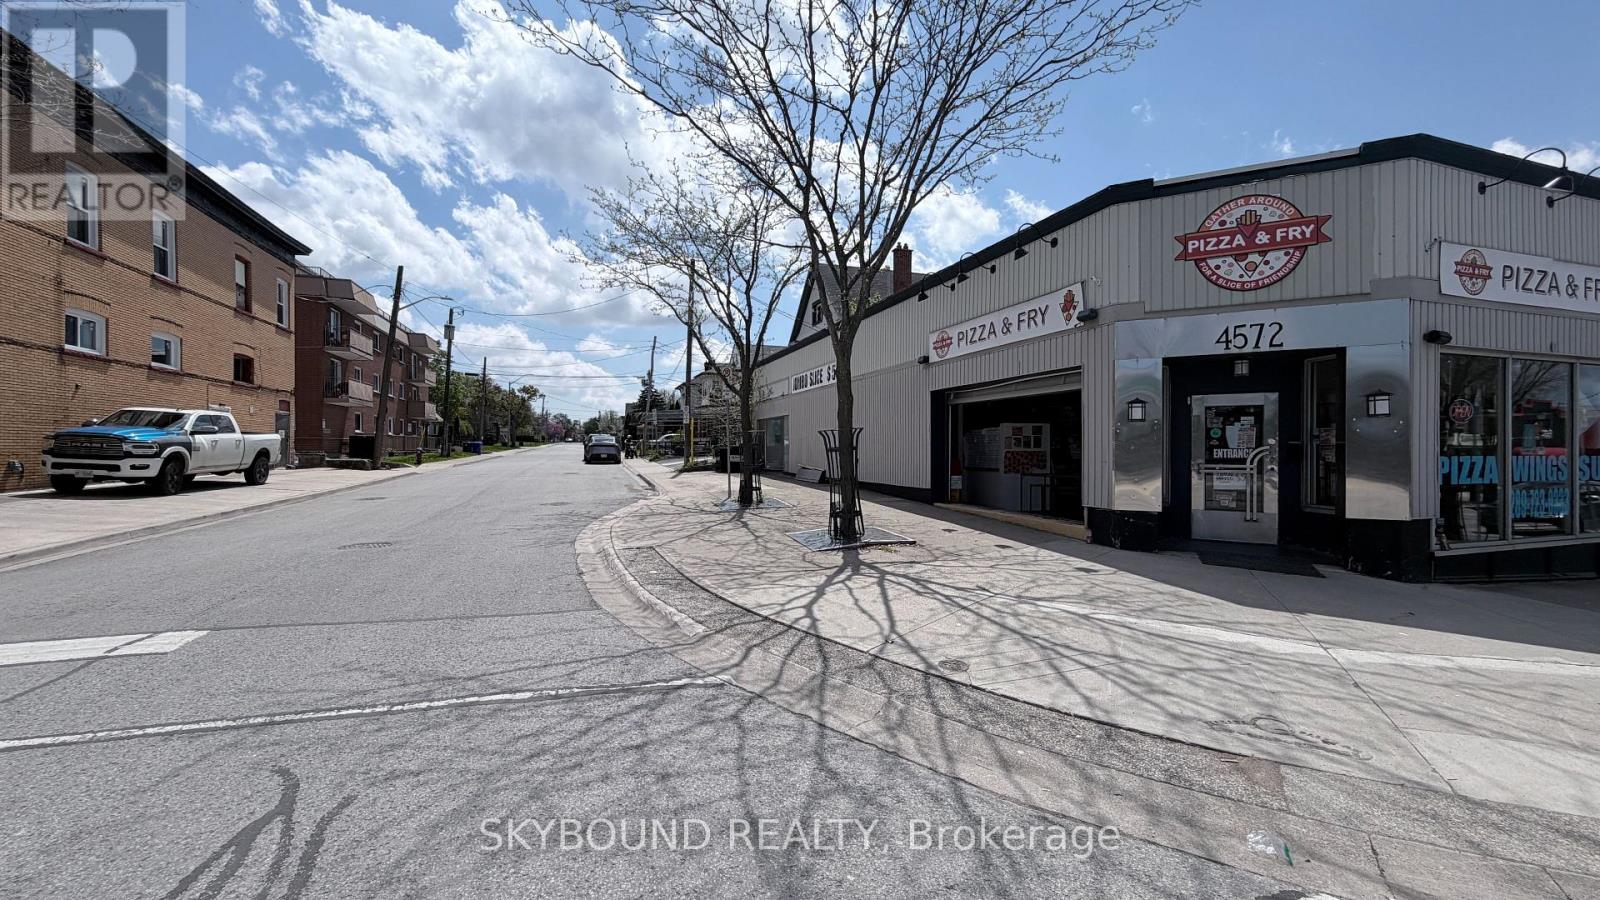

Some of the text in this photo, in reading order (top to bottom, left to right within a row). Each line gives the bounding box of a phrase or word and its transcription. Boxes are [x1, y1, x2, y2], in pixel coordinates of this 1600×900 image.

[1205, 196, 1295, 228] GATHER AROUND
[1187, 223, 1315, 253] PIZZA & FRY
[1199, 262, 1212, 278] FOR
[1217, 278, 1242, 289] SLICE
[1258, 250, 1301, 287] FRIENDSHIP
[1501, 264, 1561, 297] PIZZA
[1565, 273, 1579, 299] &
[957, 321, 998, 348] PIZZA
[1001, 316, 1013, 336] &
[1017, 304, 1050, 331] FRY
[1214, 321, 1284, 351] 4572
[1440, 455, 1499, 485] PIZZA
[1511, 454, 1568, 482] WINGS
